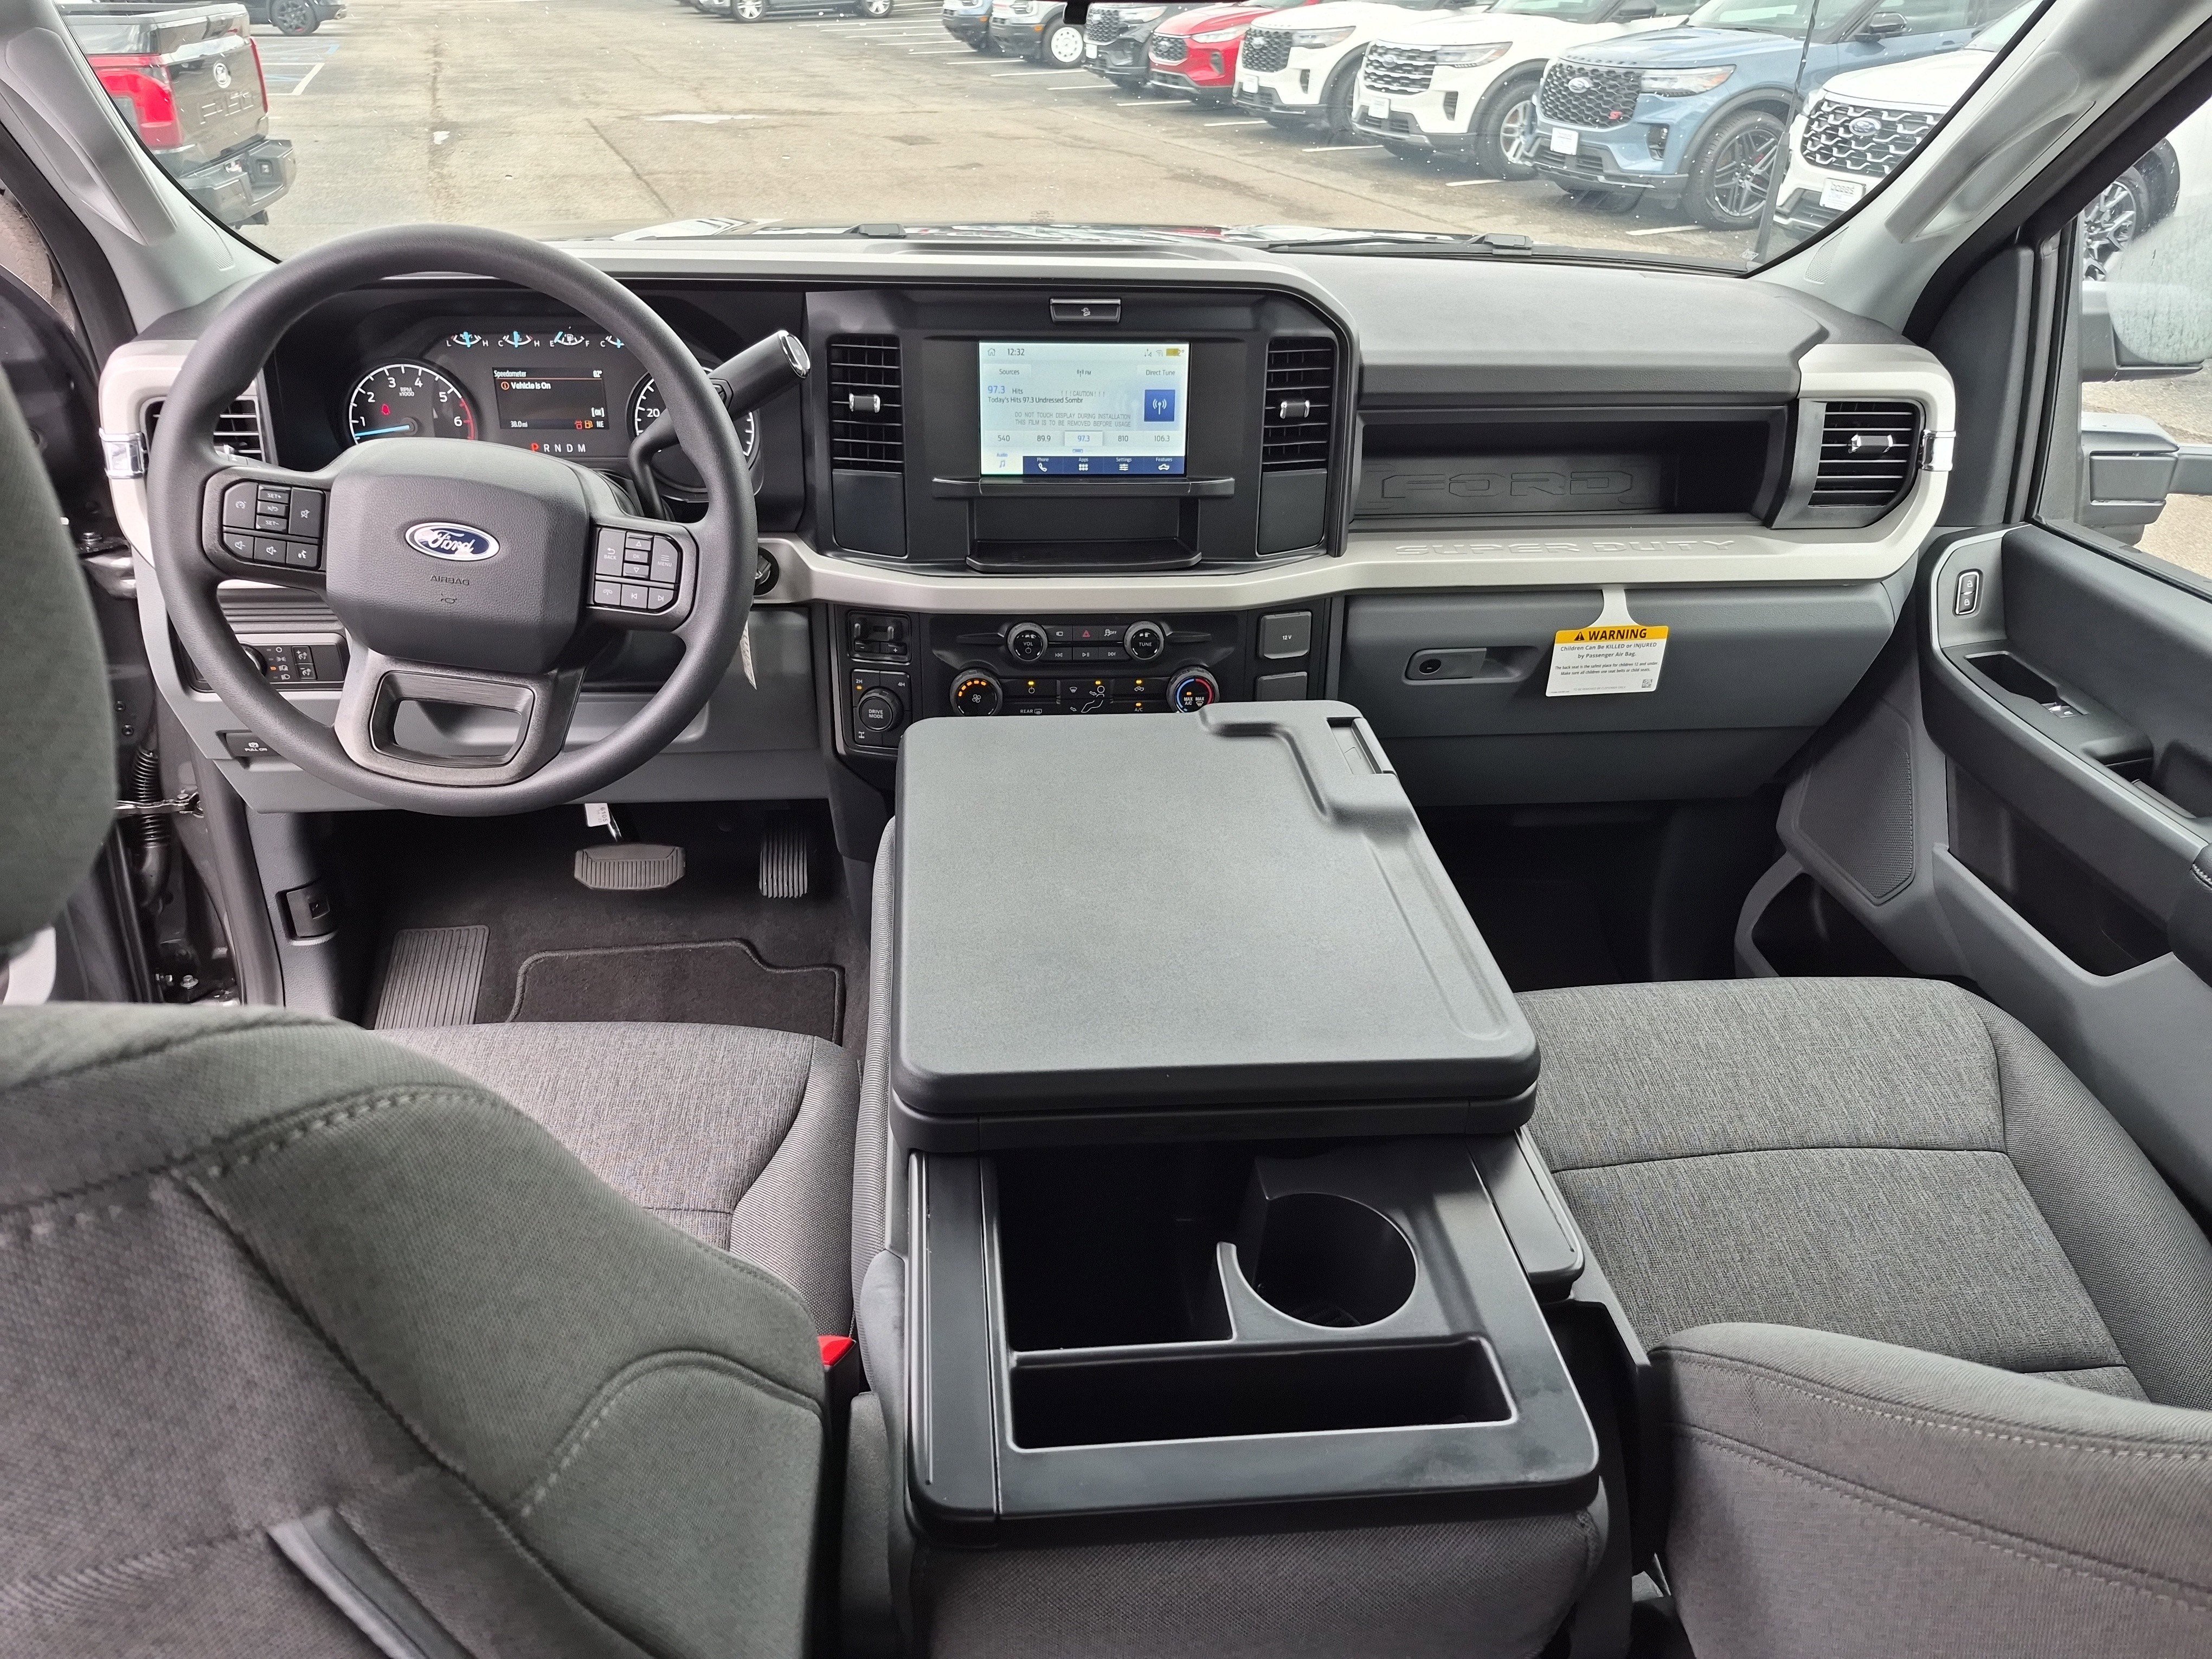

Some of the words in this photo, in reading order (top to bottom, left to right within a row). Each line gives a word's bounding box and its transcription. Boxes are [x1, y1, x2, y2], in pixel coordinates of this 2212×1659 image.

[387, 377, 396, 388] 3
[414, 377, 423, 388] 4
[988, 385, 1005, 394] 97.3
[367, 391, 376, 403] 2
[439, 391, 448, 402] 5
[647, 408, 660, 417] 20
[360, 416, 365, 427] 1
[454, 416, 462, 427] 6
[531, 443, 539, 452] P
[543, 443, 550, 452] R
[555, 443, 561, 452] N
[567, 443, 573, 452] D
[577, 443, 586, 452] M
[1382, 471, 1633, 498] FORD
[428, 528, 475, 554] Ford
[1395, 543, 1580, 555] SUPER
[1592, 541, 1735, 552] DUTY
[430, 575, 470, 586] AIRBAG
[1589, 628, 1647, 640] WARNING
